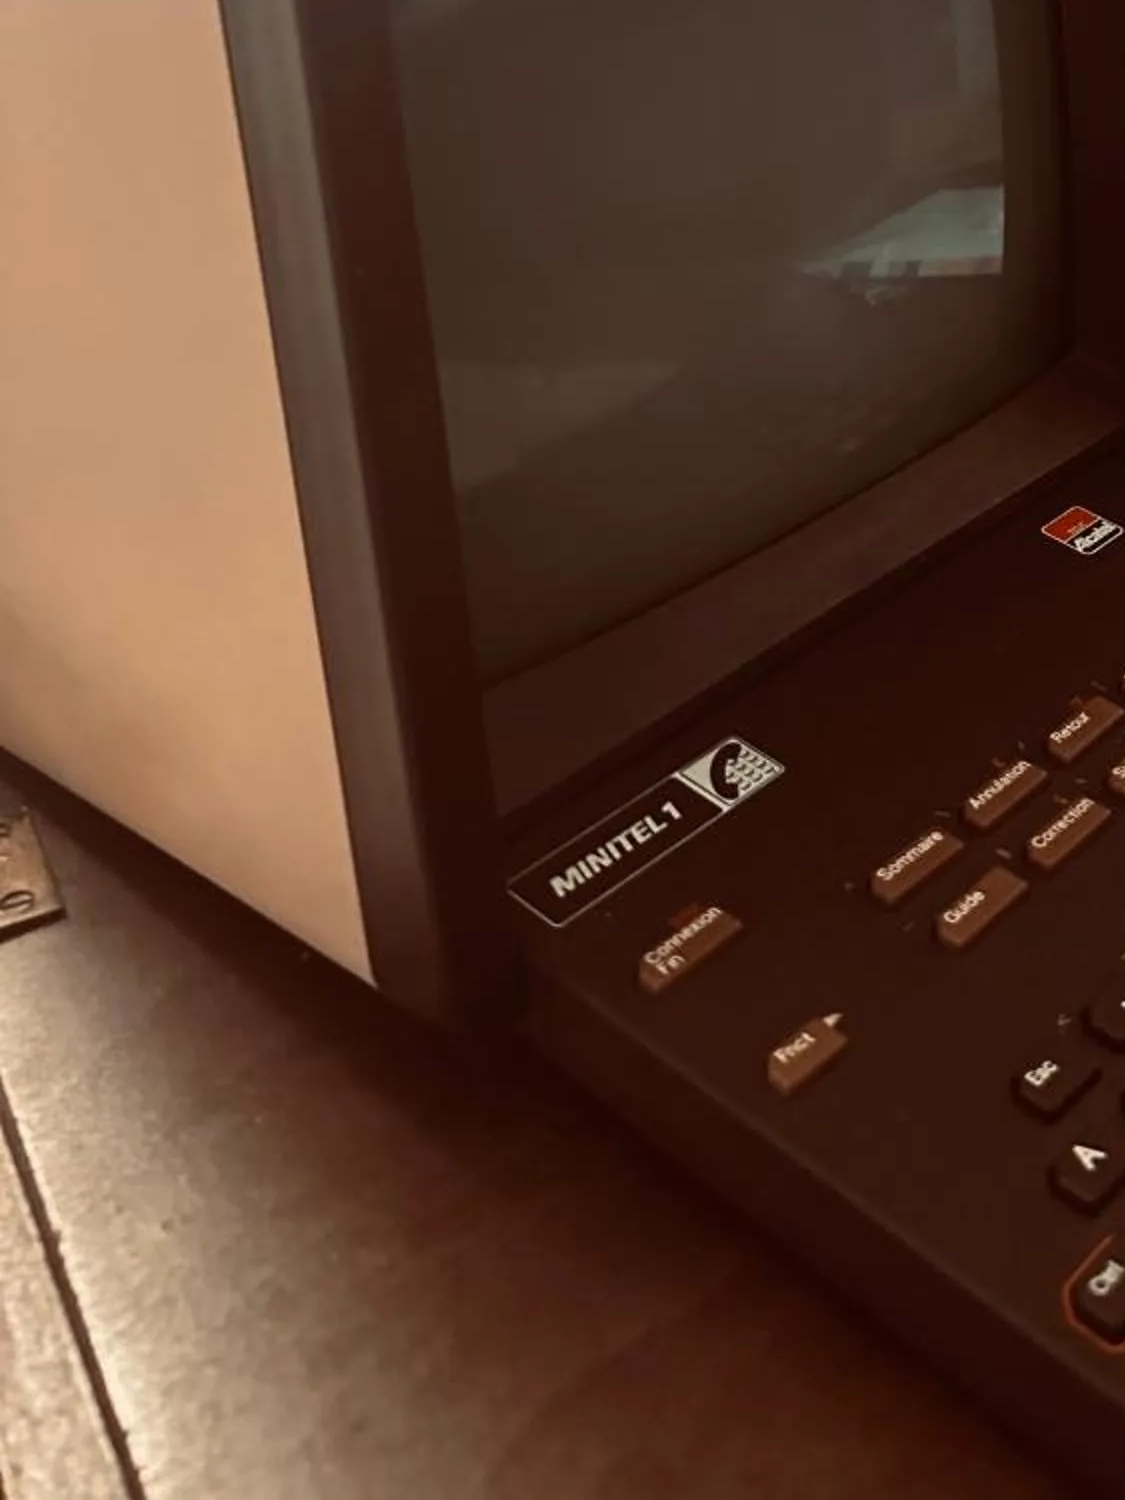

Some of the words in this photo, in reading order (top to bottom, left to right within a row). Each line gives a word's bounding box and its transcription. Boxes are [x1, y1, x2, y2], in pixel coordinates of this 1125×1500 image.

[1050, 711, 1090, 744] Retour
[968, 760, 1031, 809] Annulation
[1030, 797, 1094, 849] Correction
[549, 814, 669, 898] MINITEL
[661, 801, 683, 821] 1
[876, 831, 944, 880] Sommaire
[943, 891, 985, 923] Guide
[644, 907, 723, 964] Connexion
[656, 954, 685, 975] Fin
[773, 1032, 816, 1063] Fnct
[1072, 1145, 1106, 1171] A
